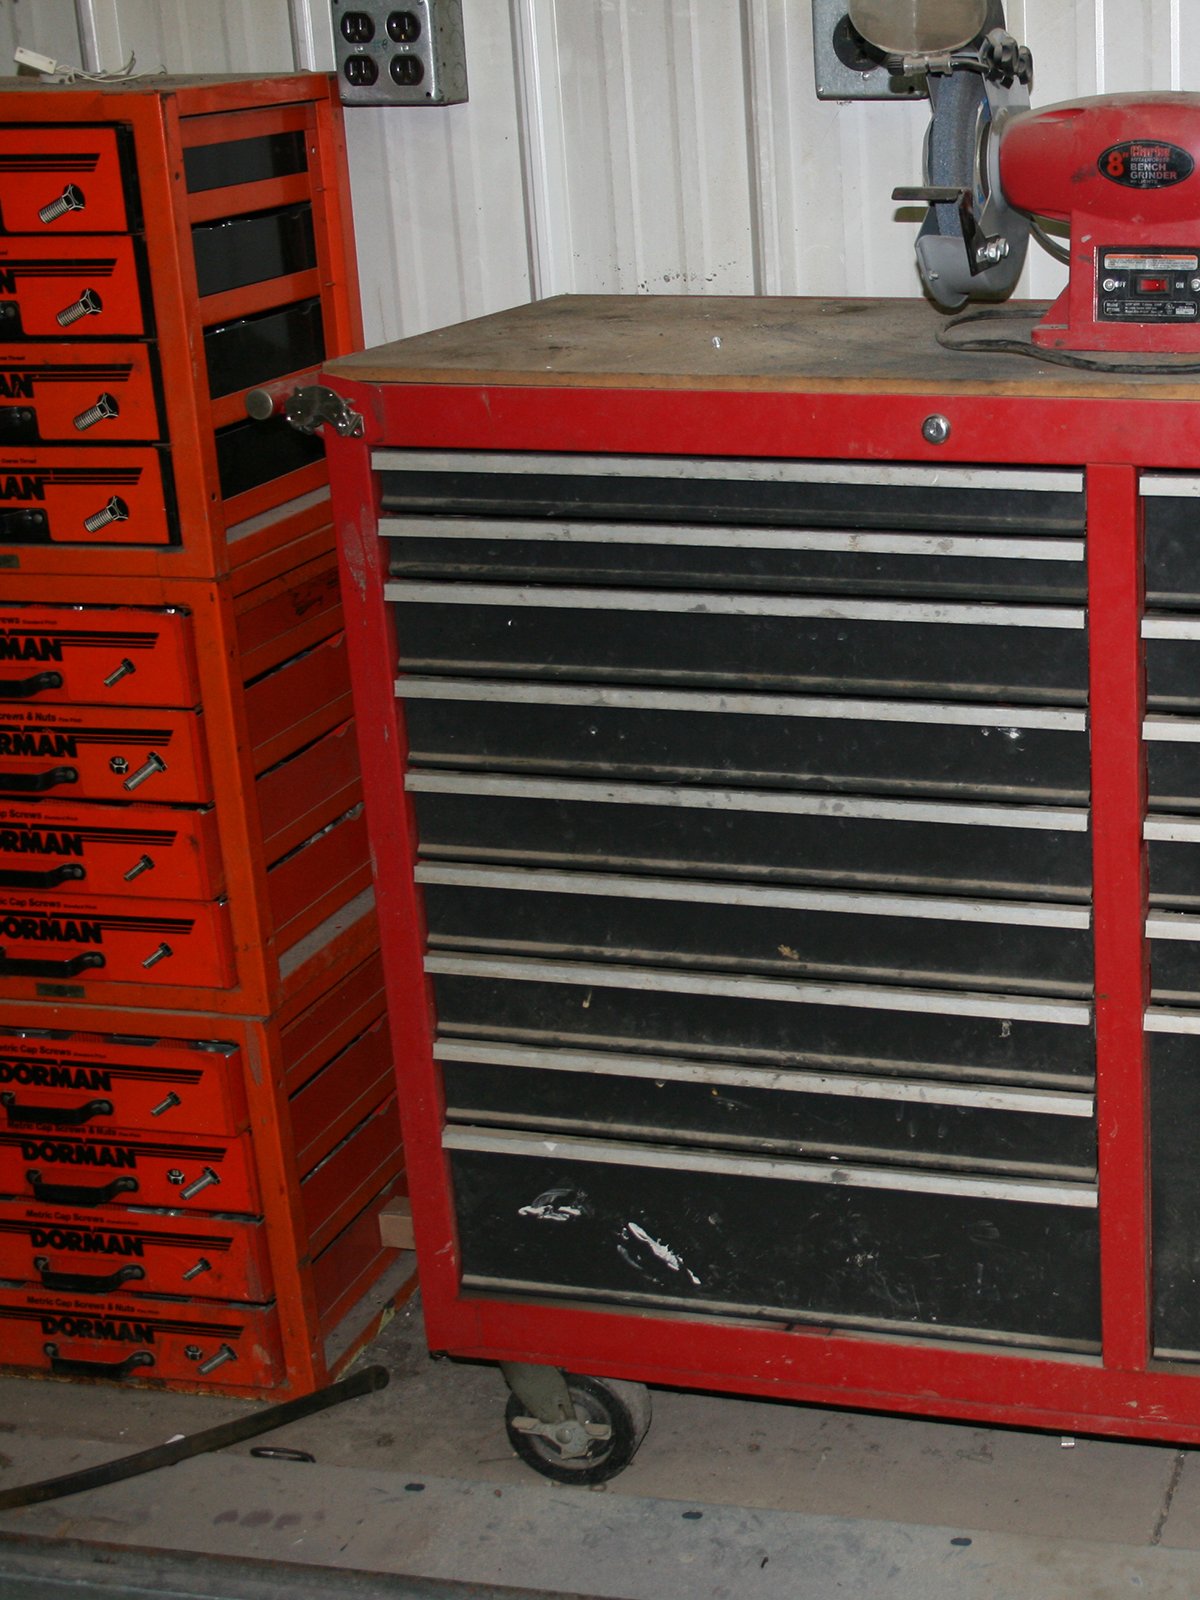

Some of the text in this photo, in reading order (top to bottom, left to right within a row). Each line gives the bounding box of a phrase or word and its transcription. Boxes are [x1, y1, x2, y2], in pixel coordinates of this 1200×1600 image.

[1130, 163, 1167, 172] BENCH
[1130, 171, 1178, 180] GRINDER
[35, 712, 57, 723] Nuts
[9, 809, 42, 819] Screws
[0, 829, 84, 857] RMAN
[9, 897, 27, 908] Cap
[28, 898, 61, 908] Screws
[20, 1045, 38, 1056] Cap
[39, 1045, 72, 1056] Screws
[0, 1062, 112, 1091] DORMAN
[21, 1140, 137, 1169] DORMAN
[26, 1209, 53, 1219] Metric
[54, 1211, 72, 1223] Cap
[72, 1213, 104, 1224] Screws
[31, 1228, 145, 1257] DORMAN
[27, 1295, 53, 1305] Metric
[54, 1298, 73, 1309] Cap
[73, 1300, 105, 1311] Screws
[114, 1303, 135, 1313] Nuts
[41, 1316, 155, 1345] DORMAN
